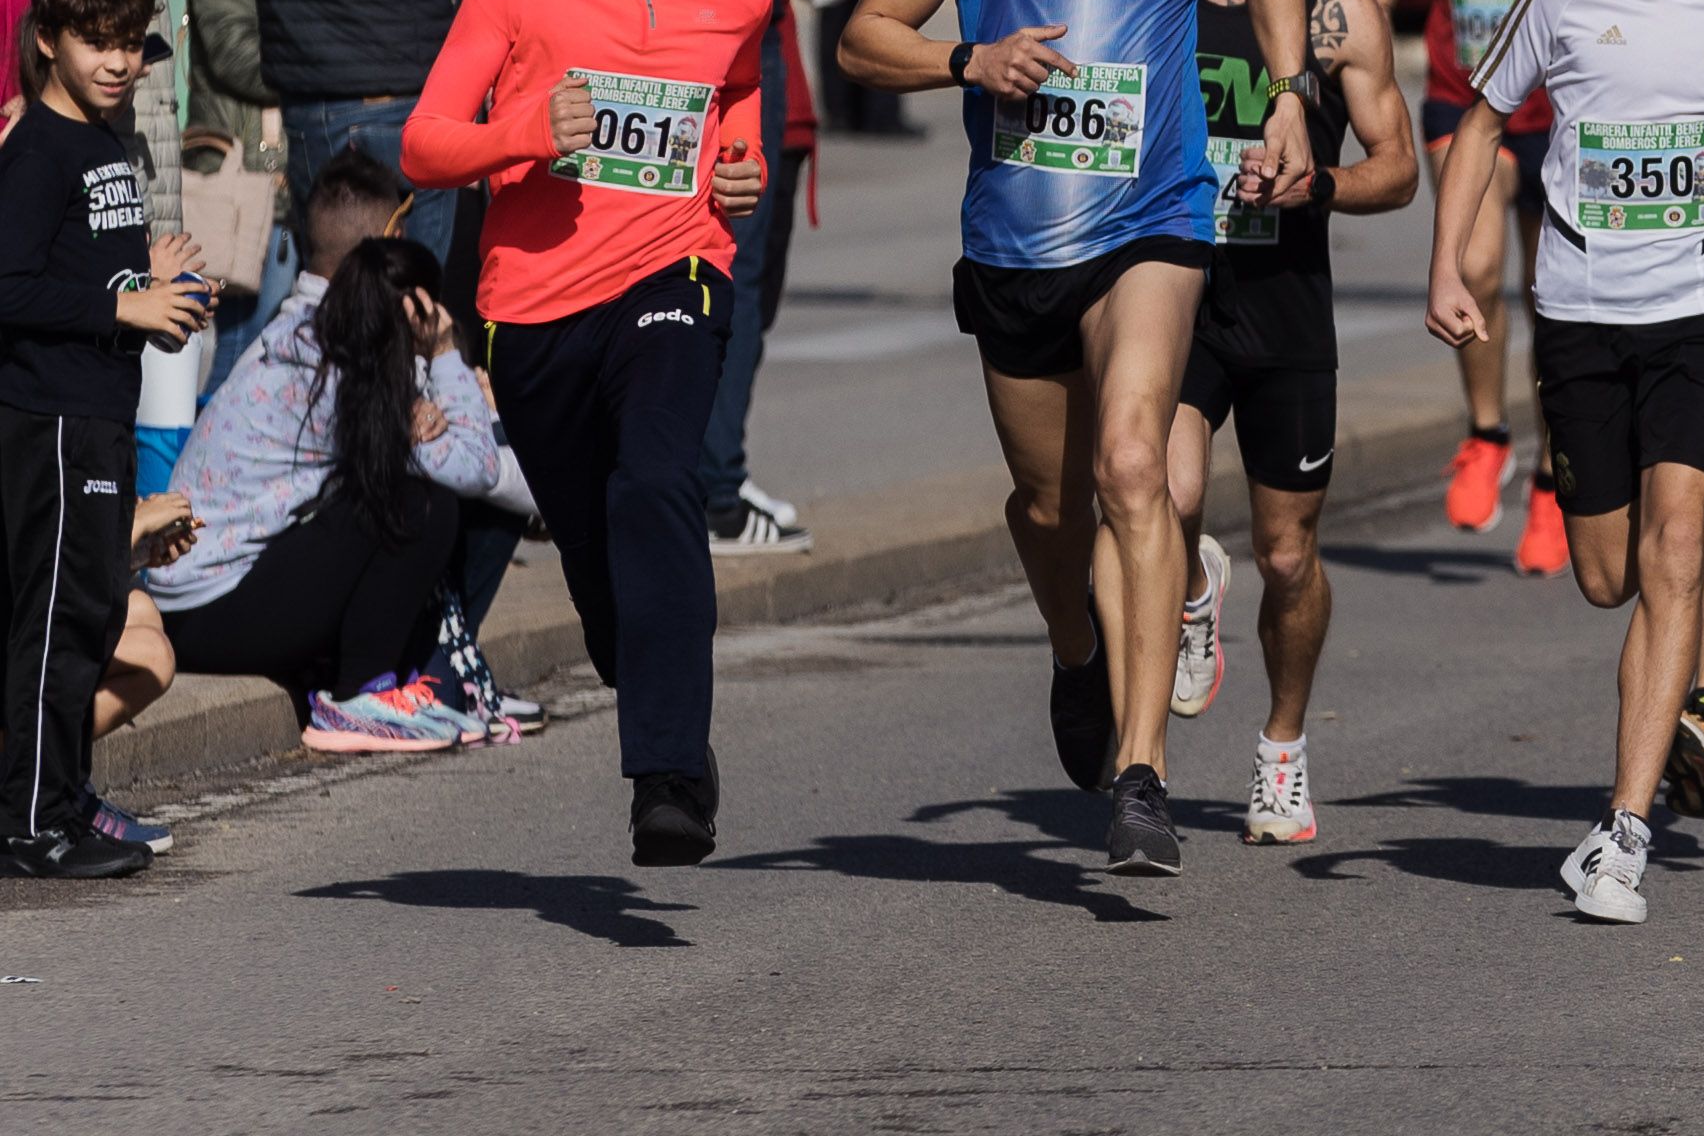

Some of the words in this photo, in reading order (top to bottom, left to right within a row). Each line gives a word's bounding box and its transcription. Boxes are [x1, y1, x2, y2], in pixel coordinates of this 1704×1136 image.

[619, 77, 663, 96] INFANTIL
[1073, 77, 1088, 91] DE
[1089, 79, 1120, 93] JEREZ
[590, 87, 645, 106] BOMBEROS
[645, 94, 660, 108] DE
[660, 96, 689, 111] JEREZ
[1025, 92, 1107, 140] 086
[591, 108, 672, 159] 061
[1583, 122, 1628, 138] CARRERA
[1630, 124, 1674, 137] INFANTIL
[1602, 136, 1657, 150] BOMBEROS
[1659, 136, 1673, 149] DE
[1673, 135, 1702, 149] JEREZ
[1610, 155, 1694, 199] 350
[637, 308, 695, 328] Gedo
